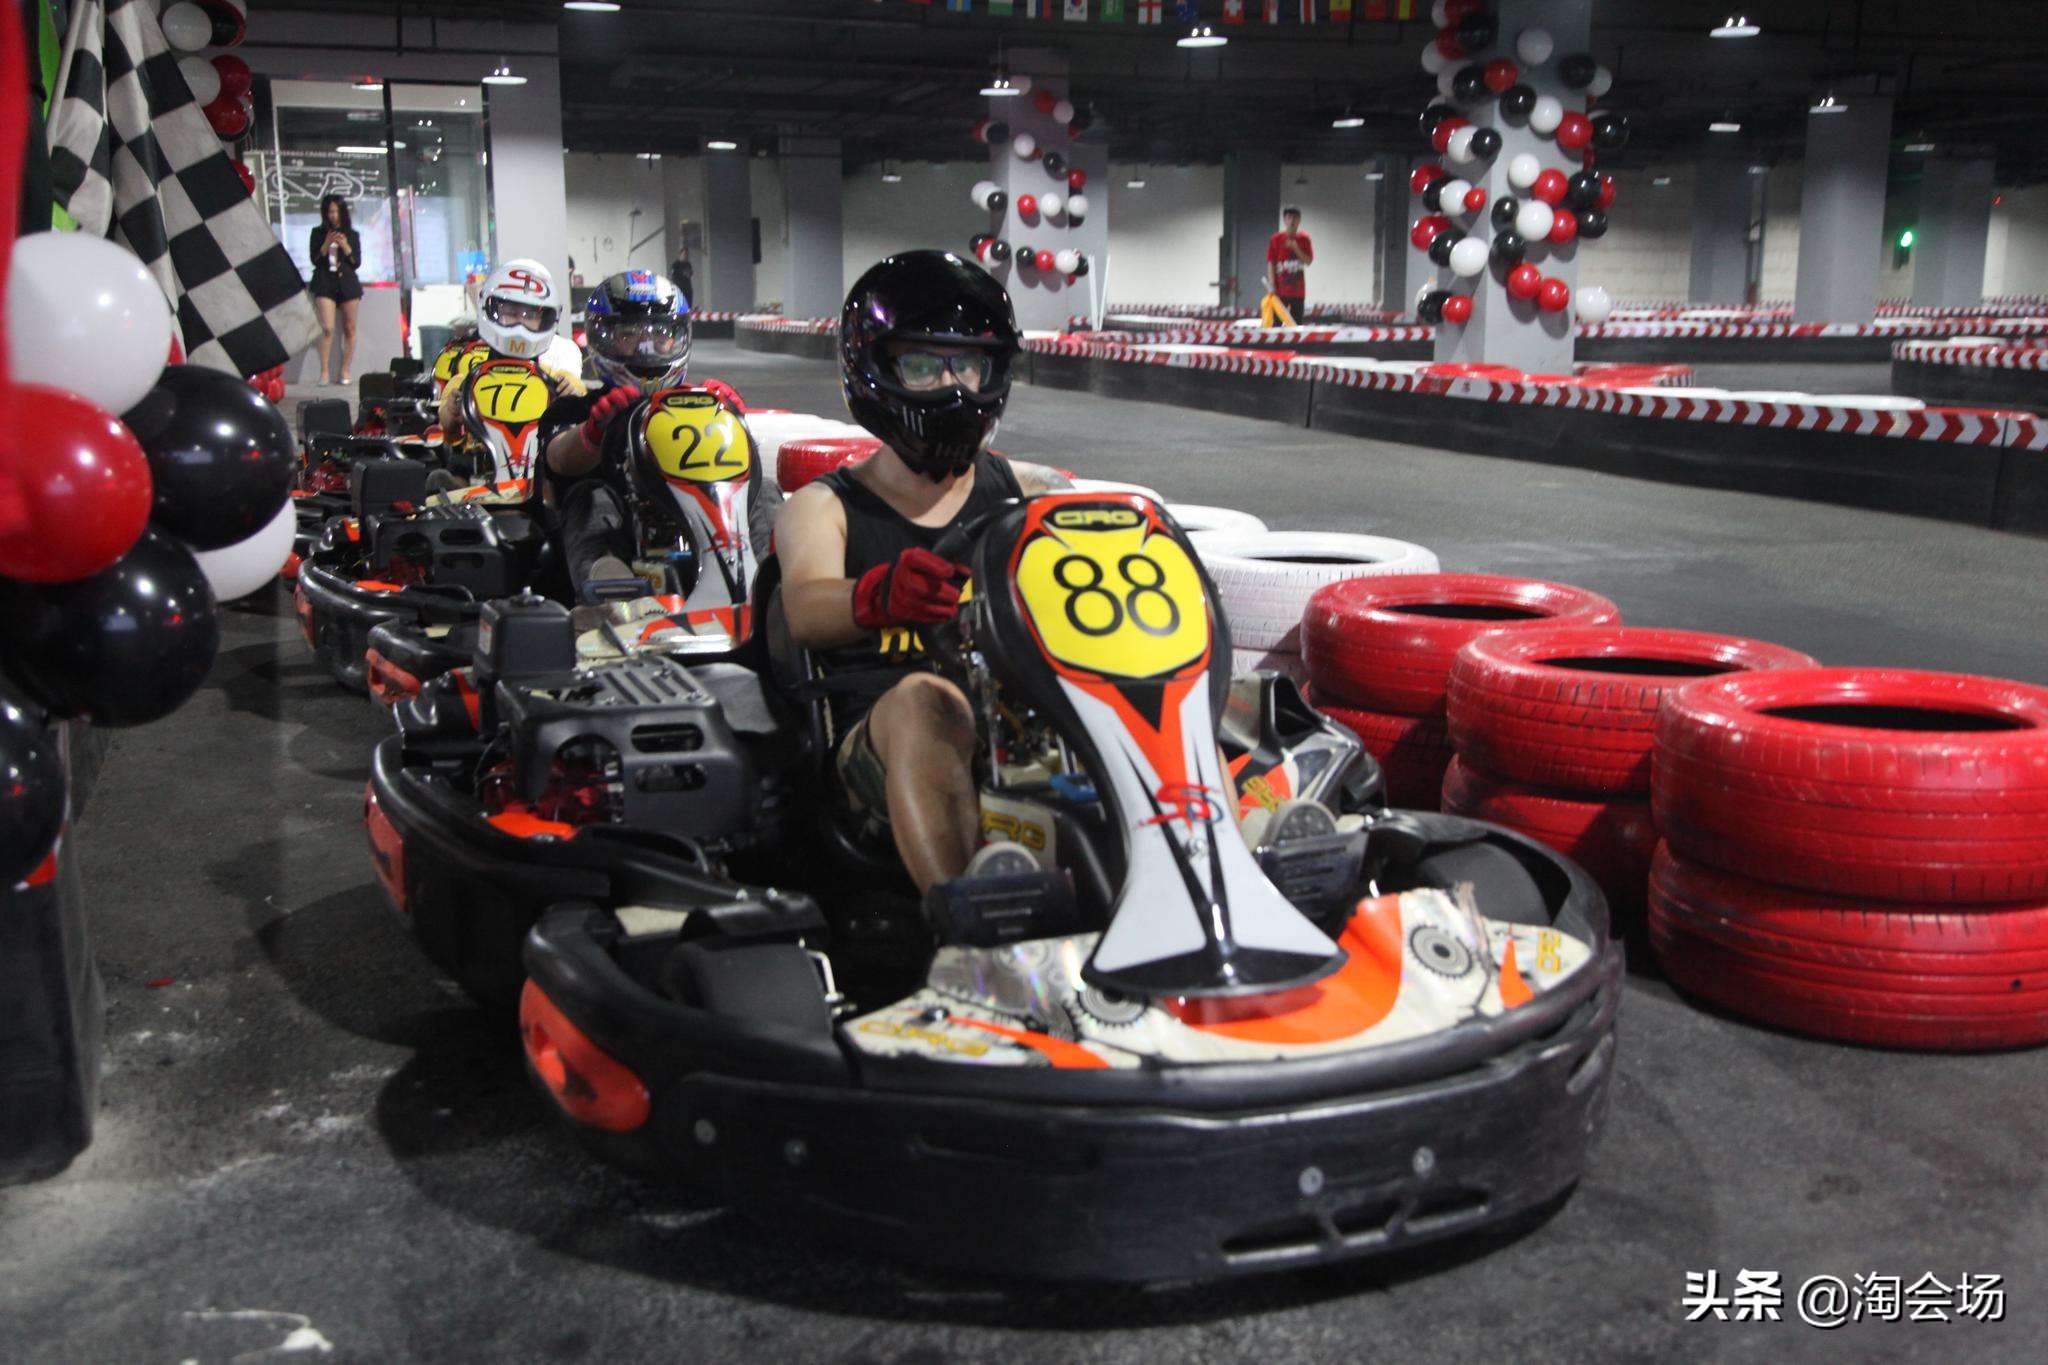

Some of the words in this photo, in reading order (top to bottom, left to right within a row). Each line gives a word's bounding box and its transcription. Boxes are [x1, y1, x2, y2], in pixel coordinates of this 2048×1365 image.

[480, 382, 528, 426] 77
[671, 423, 743, 470] 22
[1053, 553, 1180, 637] 88
